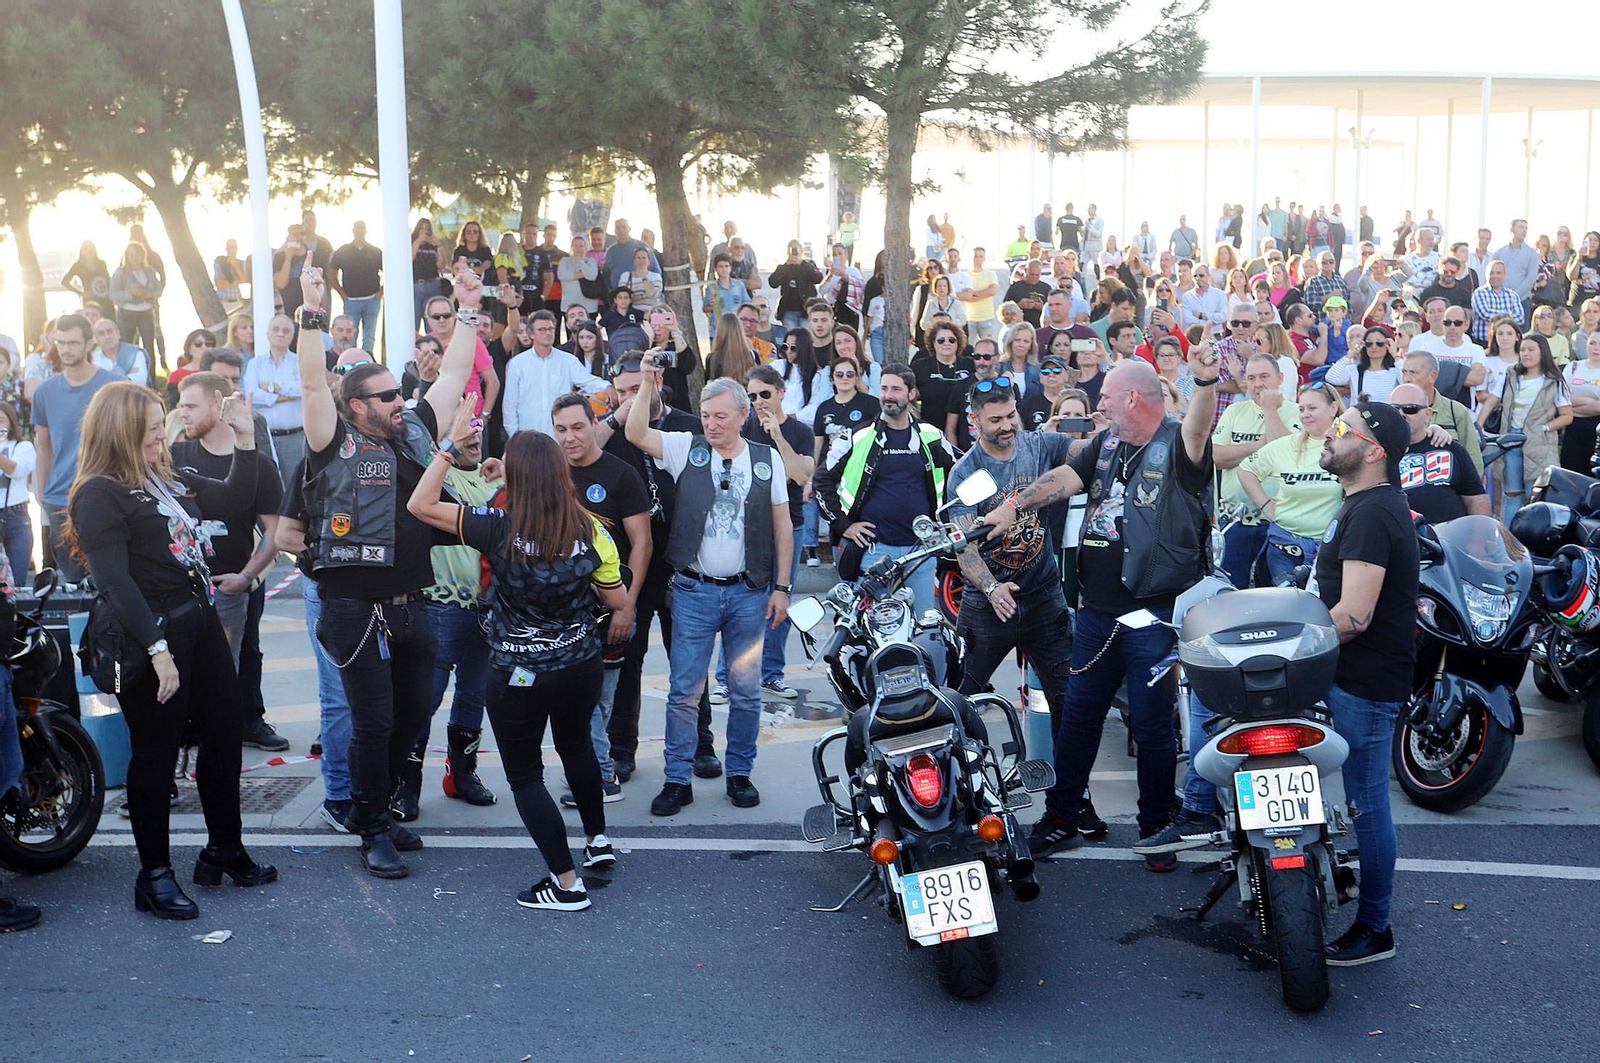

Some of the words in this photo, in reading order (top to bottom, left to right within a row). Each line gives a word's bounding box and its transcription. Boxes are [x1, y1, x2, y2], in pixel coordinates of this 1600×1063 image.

[629, 313, 636, 324] 9
[1399, 450, 1453, 489] 69
[1240, 630, 1277, 641] SHAD
[501, 641, 549, 653] SUPER
[1256, 771, 1315, 798] 3140
[1243, 794, 1251, 804] E
[1267, 797, 1310, 823] GDW
[923, 867, 982, 900] 8916
[911, 900, 919, 909] E
[928, 897, 973, 927] FXS
